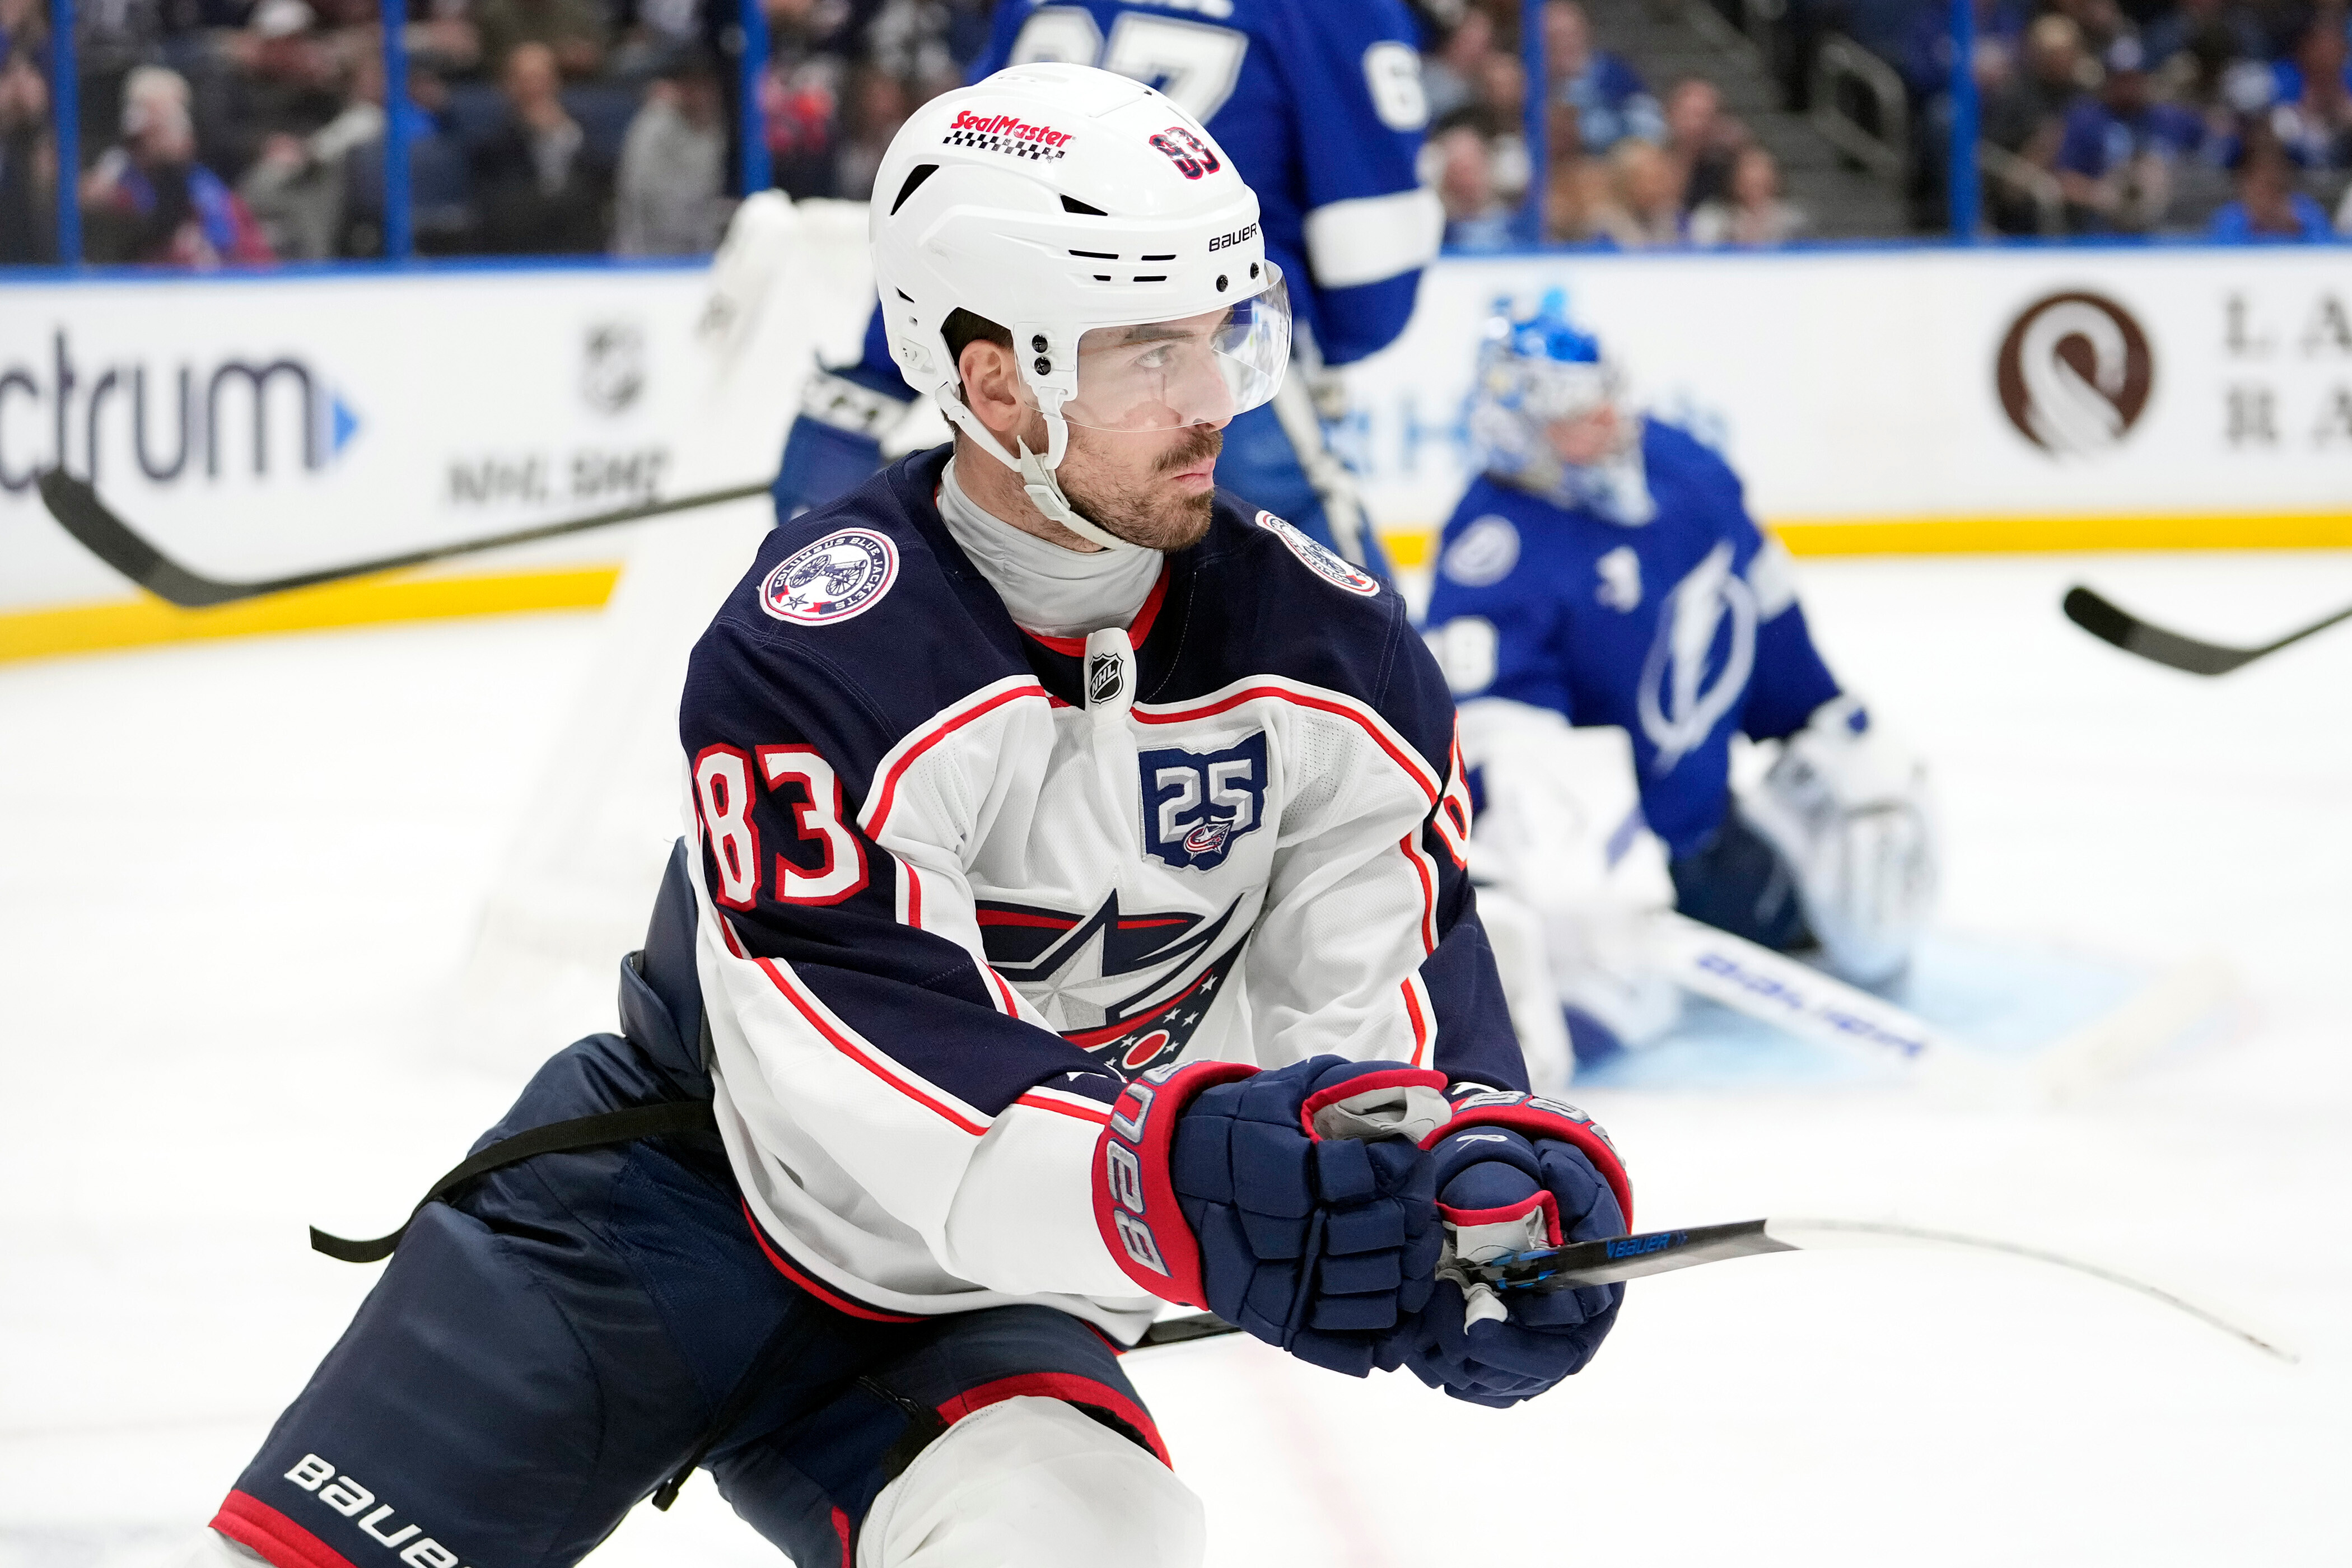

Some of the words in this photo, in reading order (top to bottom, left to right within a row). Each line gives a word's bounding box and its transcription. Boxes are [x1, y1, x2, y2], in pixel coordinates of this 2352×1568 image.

[950, 110, 1072, 148] SealMaster
[1208, 222, 1257, 252] BAUER
[774, 537, 846, 587] COLUMBUS
[849, 536, 880, 556] BLUE
[835, 559, 884, 610] JACKETS
[1090, 663, 1117, 696] NHL
[1155, 758, 1253, 844] 25
[692, 742, 870, 912] 83
[284, 1453, 472, 1568] BAUE
